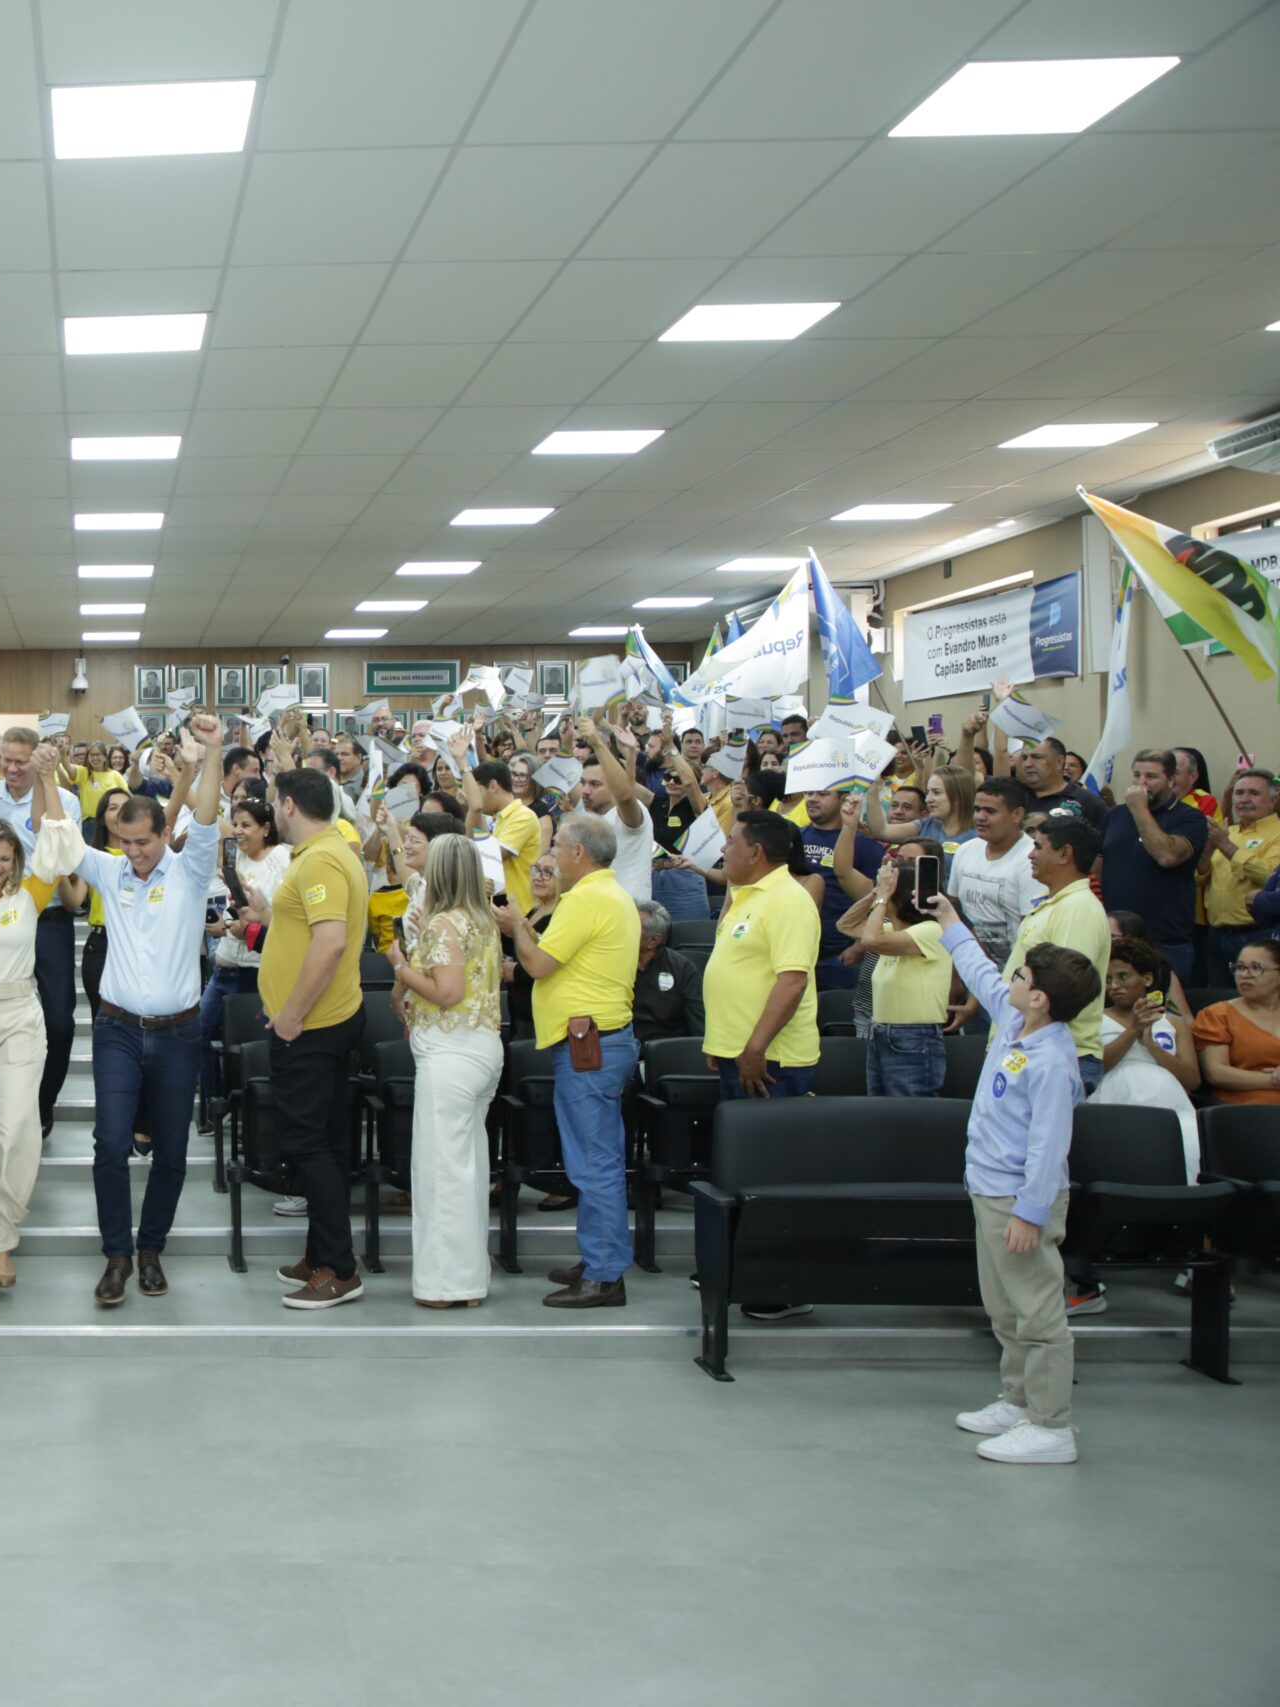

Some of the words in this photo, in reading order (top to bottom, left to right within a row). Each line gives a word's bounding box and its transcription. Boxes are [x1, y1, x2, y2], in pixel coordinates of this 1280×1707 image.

[926, 626, 933, 640] O
[935, 616, 988, 641] Progressistas
[989, 609, 1007, 626] está
[927, 646, 943, 660] com
[944, 638, 976, 657] Evandro
[977, 635, 1000, 649] Mura
[1001, 633, 1007, 644] e
[935, 659, 964, 678] Capitão
